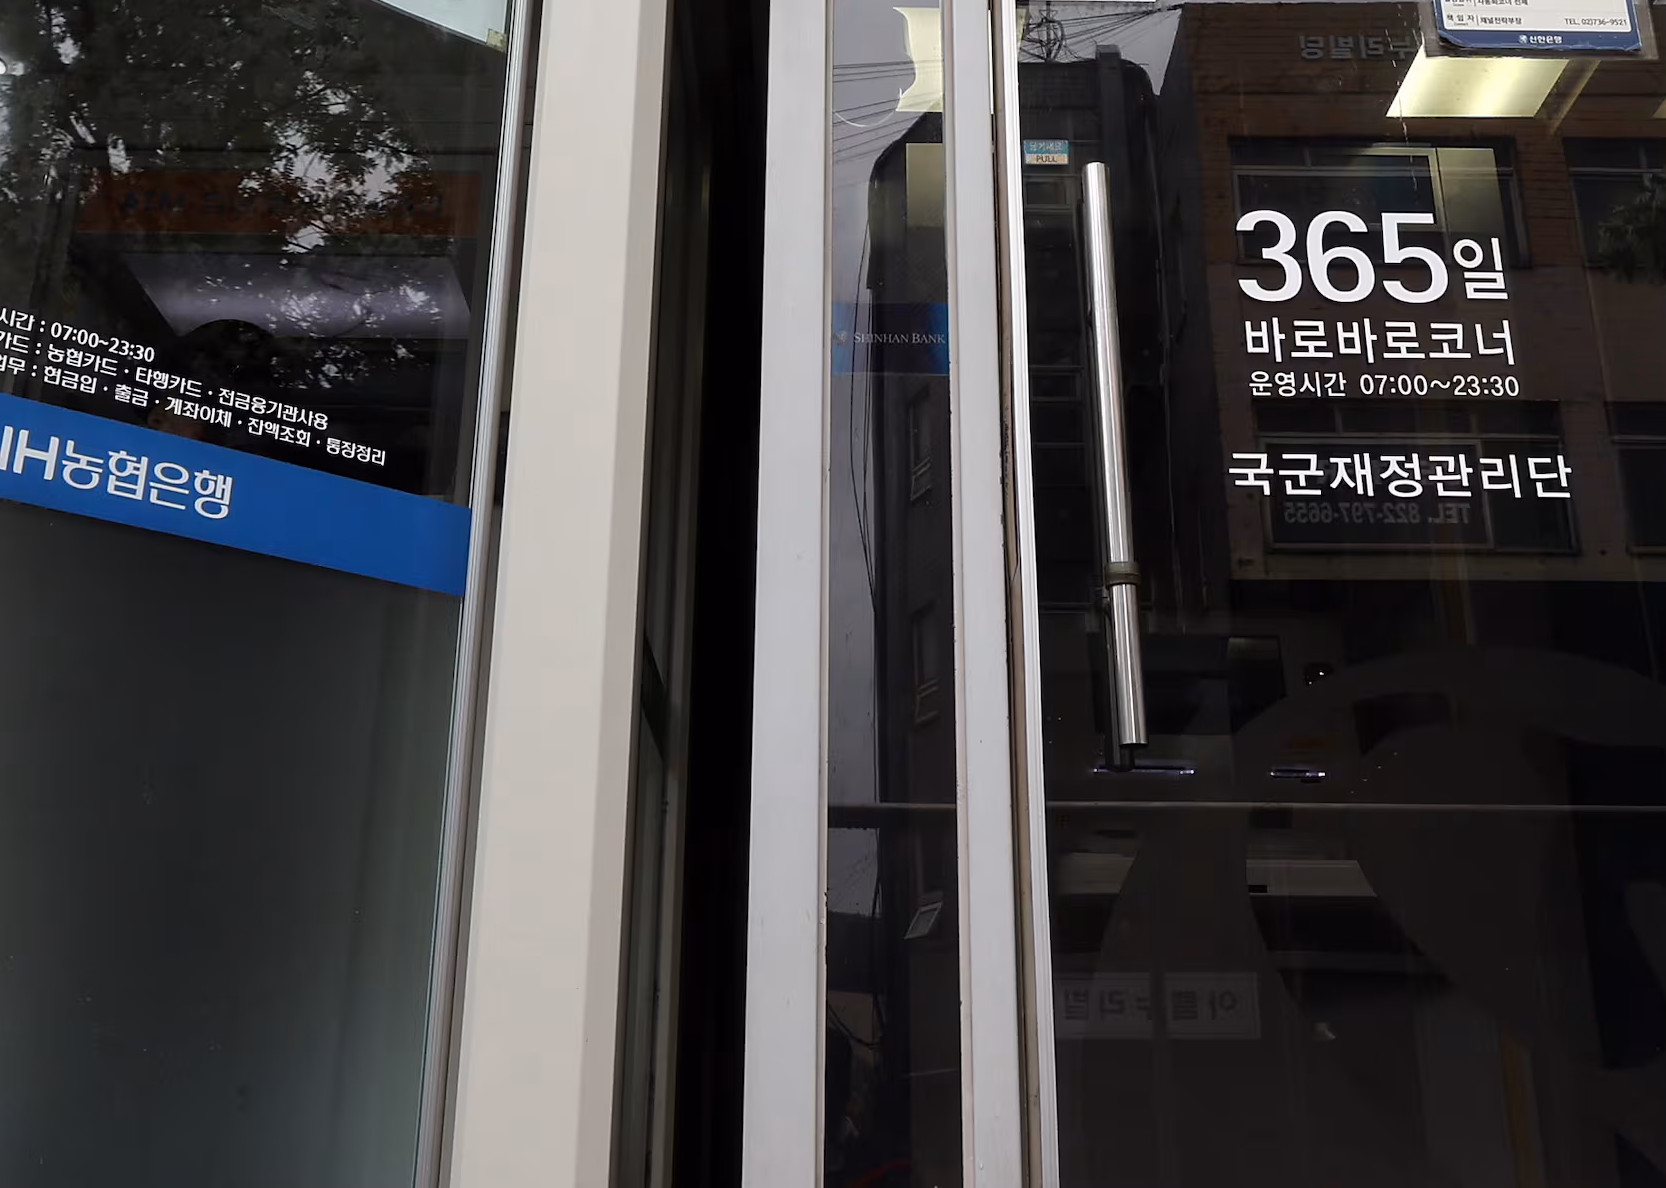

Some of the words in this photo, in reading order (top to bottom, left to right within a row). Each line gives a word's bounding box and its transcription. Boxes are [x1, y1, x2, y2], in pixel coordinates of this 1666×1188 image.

[1529, 35, 1563, 44] 신한은행
[1035, 155, 1057, 163] PULL
[1234, 208, 1509, 304] 365일
[50, 322, 155, 363] 07:00~23:30
[854, 331, 909, 344] SHINHAN
[911, 332, 946, 345] BANK
[1245, 318, 1515, 368] 바로바로코너
[47, 343, 118, 377] 농협카드
[135, 365, 203, 399] 타행카드
[217, 387, 329, 431] 전금융기관사용
[1248, 371, 1347, 399] 운영시간
[1360, 372, 1520, 398] 07:00~23:30
[114, 383, 149, 408] 출금
[164, 395, 233, 429] 계좌이체
[246, 416, 312, 448] 잔액조회
[325, 436, 387, 467] 통장정리
[1227, 451, 1573, 500] 국군재정관리단
